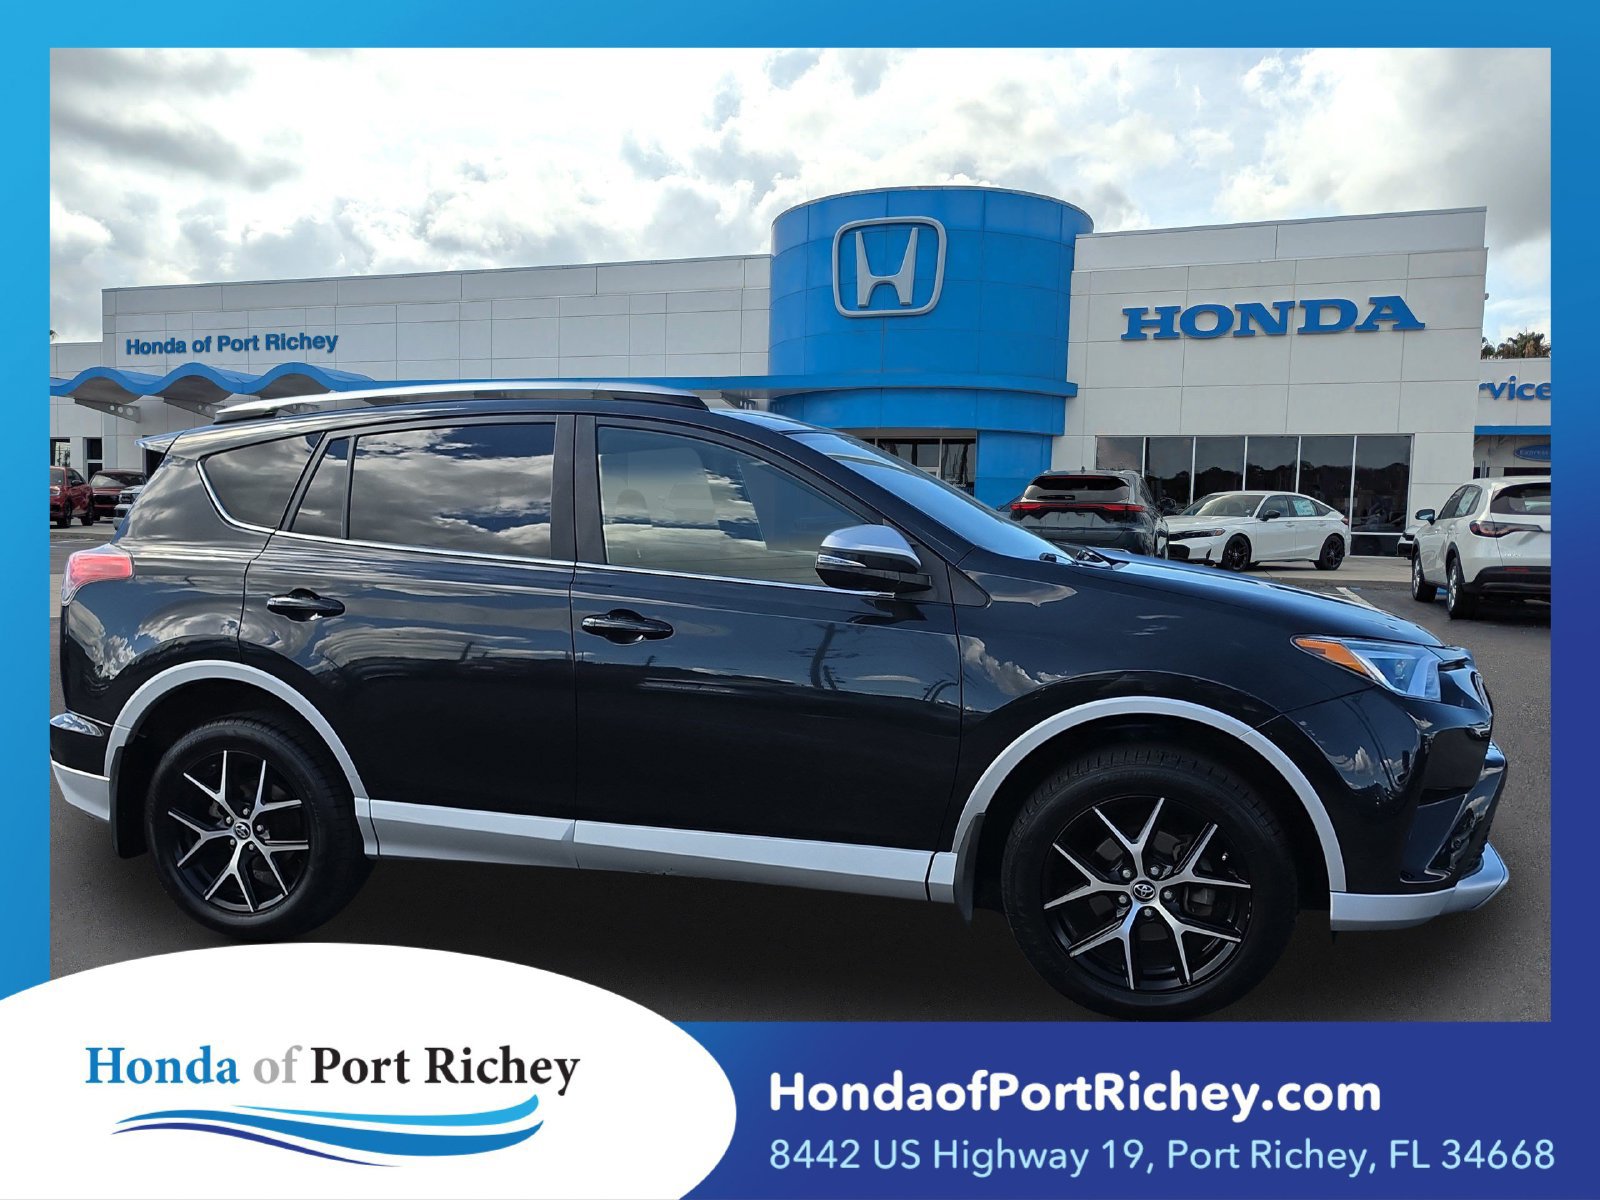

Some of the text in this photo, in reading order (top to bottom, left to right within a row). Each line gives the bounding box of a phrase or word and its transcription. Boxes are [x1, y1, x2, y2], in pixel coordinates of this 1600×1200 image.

[1120, 295, 1426, 341] HONDA
[125, 332, 339, 355] Honda of Port Richey
